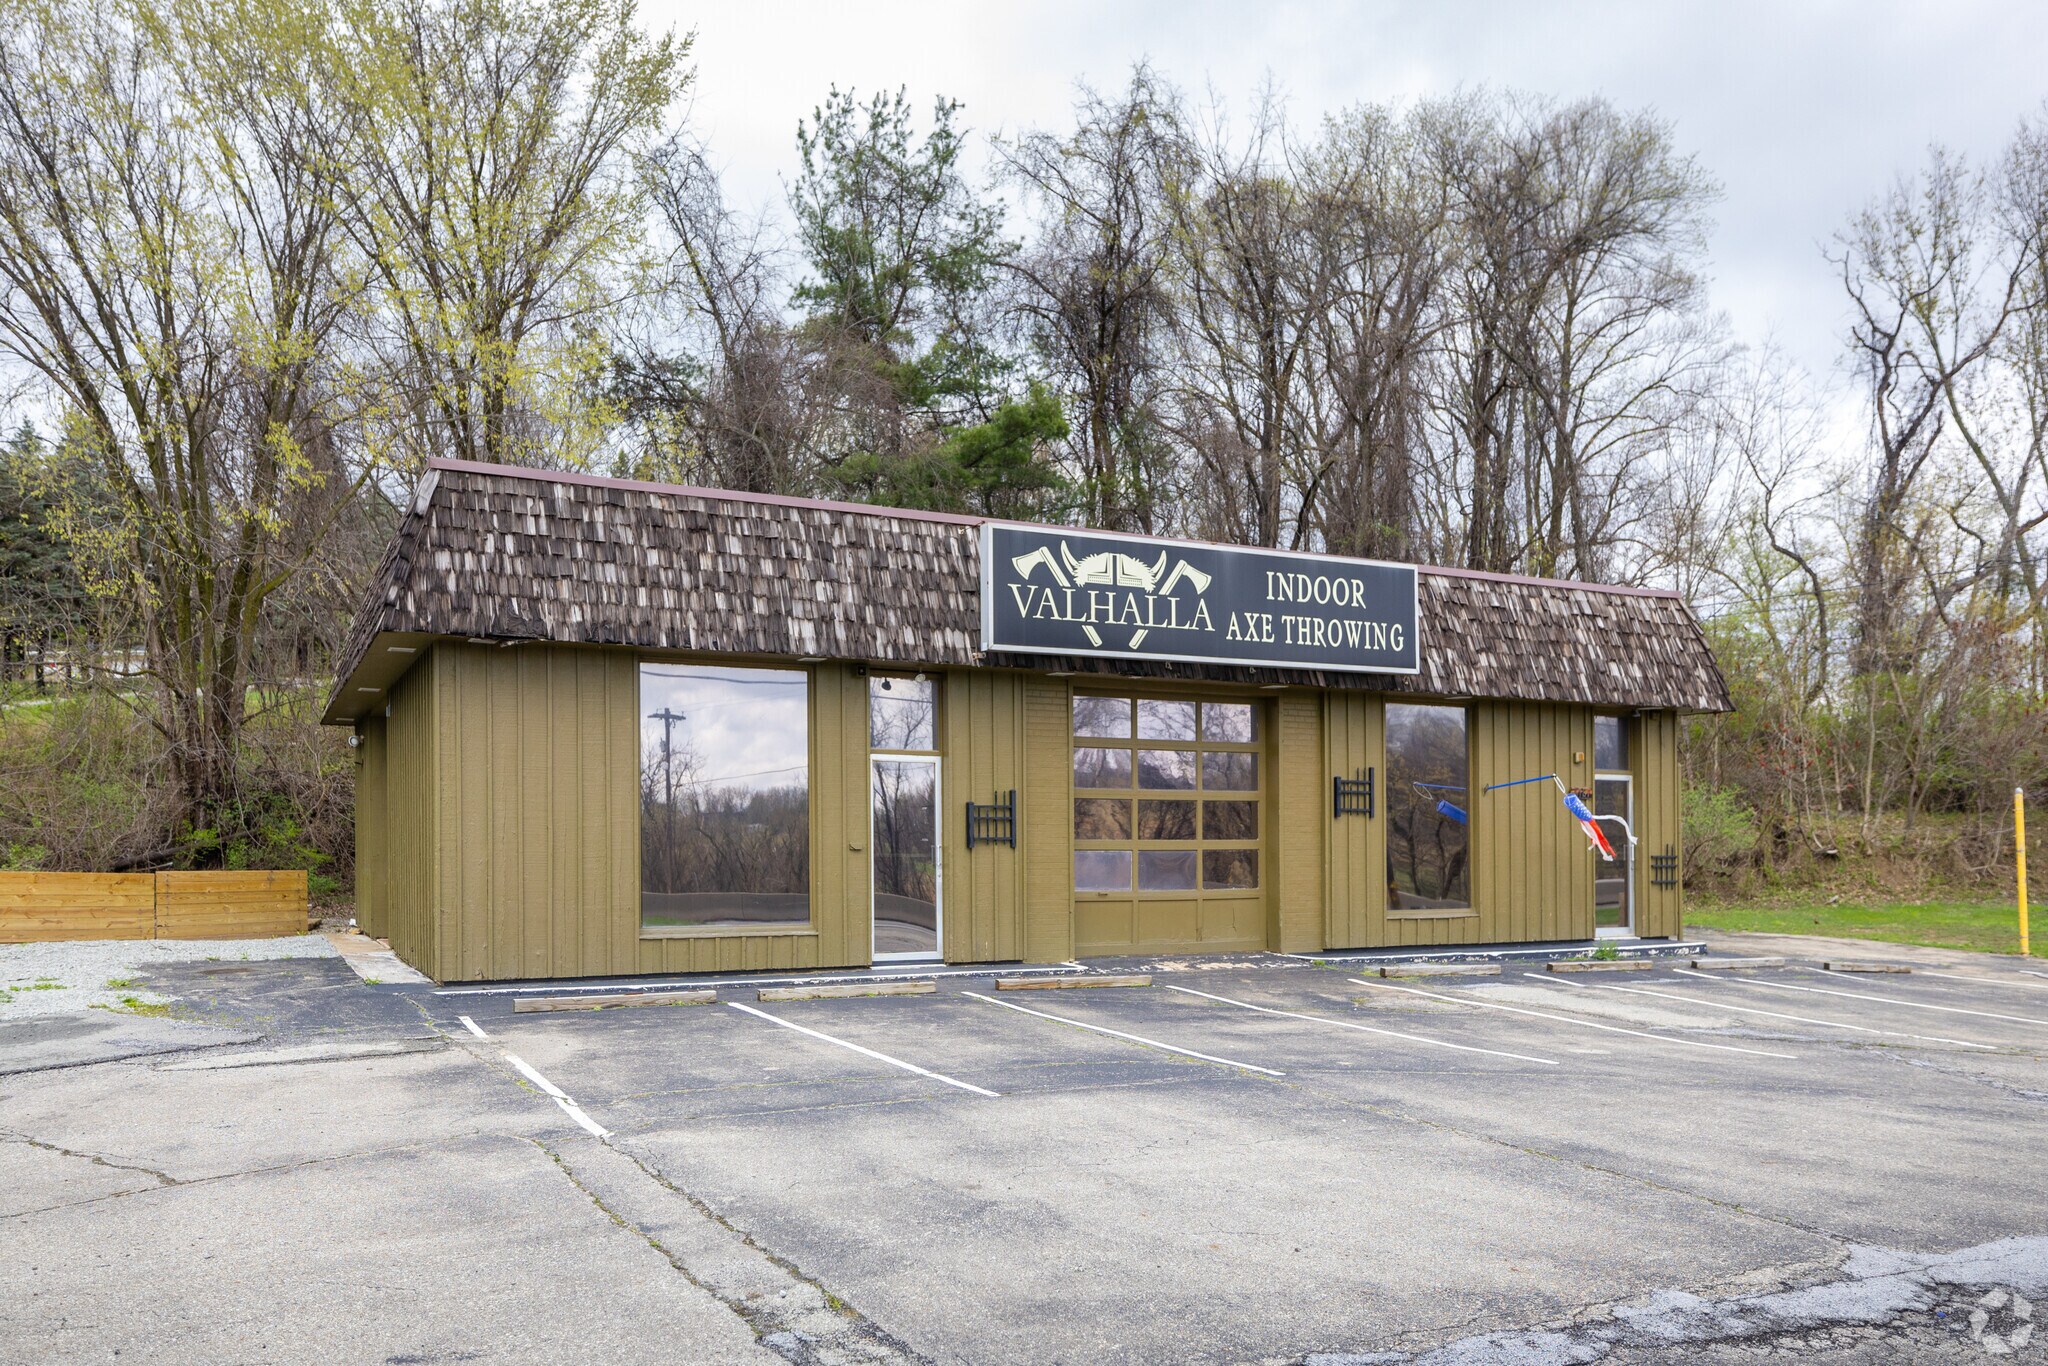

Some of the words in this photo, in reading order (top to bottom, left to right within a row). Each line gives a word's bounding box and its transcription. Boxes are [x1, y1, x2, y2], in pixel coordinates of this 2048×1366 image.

[1007, 583, 1216, 631] VALHALLA
[1266, 571, 1367, 609] INDOOR
[1226, 611, 1275, 643] AXE
[1281, 615, 1404, 652] THROWING
